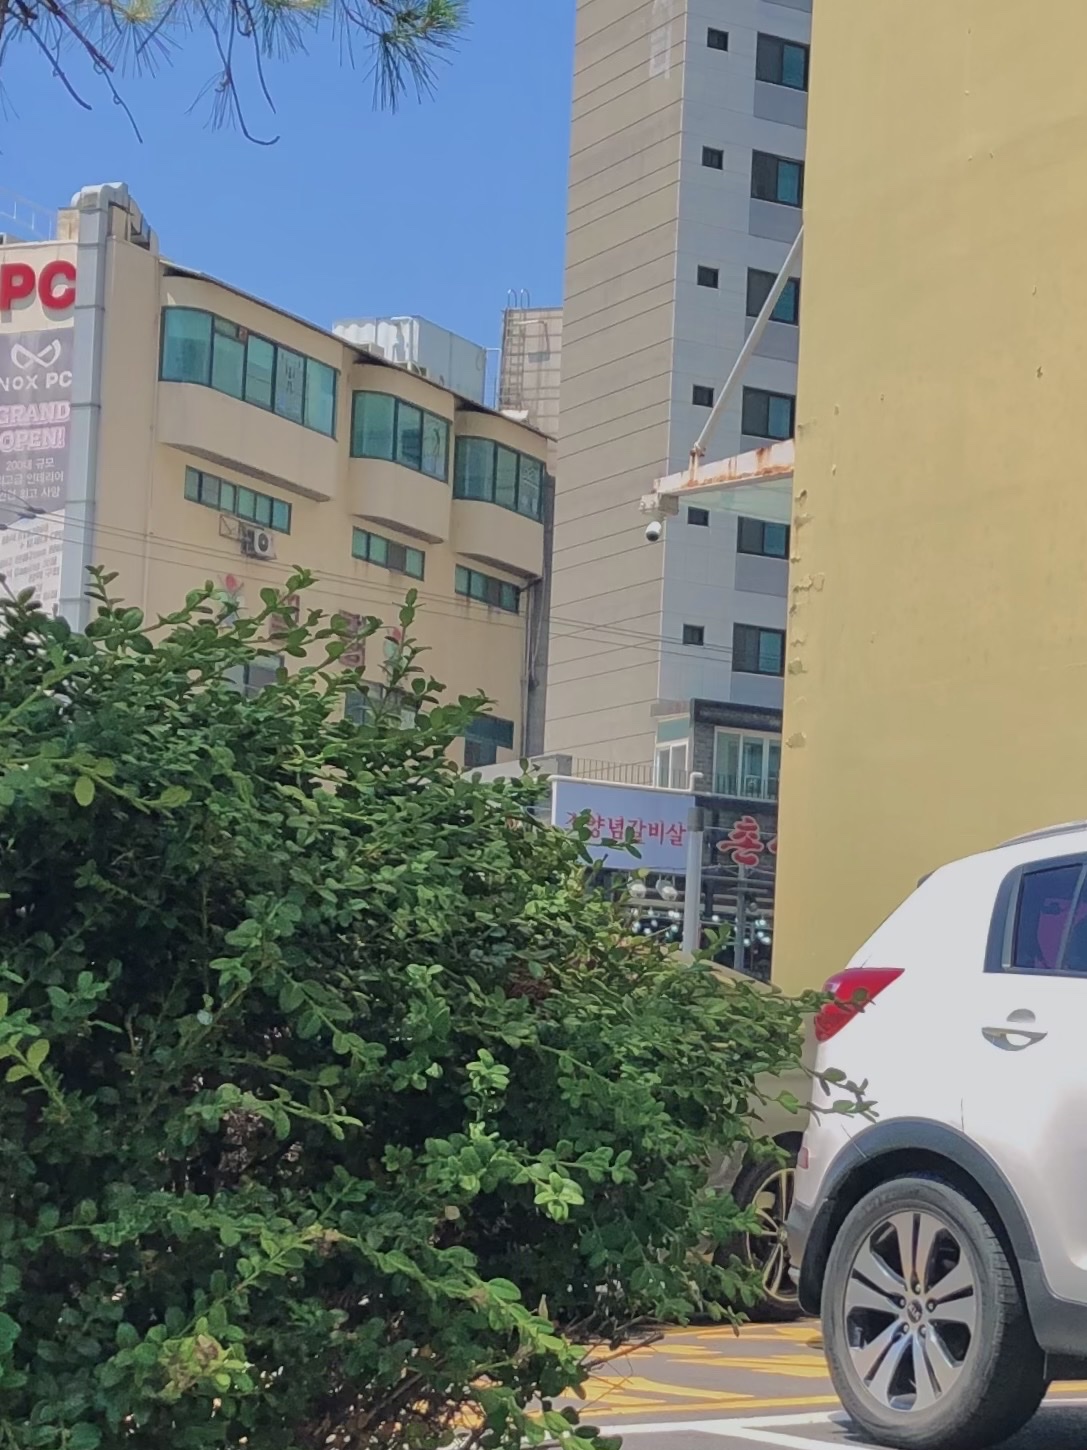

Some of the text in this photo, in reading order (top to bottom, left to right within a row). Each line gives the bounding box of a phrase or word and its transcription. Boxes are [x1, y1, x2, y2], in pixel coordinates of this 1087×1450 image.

[0, 260, 76, 310] PC
[46, 371, 72, 389] PC
[0, 426, 66, 450] OPEN!
[35, 457, 55, 470] 규모
[26, 471, 64, 485] 인테리어
[41, 485, 60, 498] 사양
